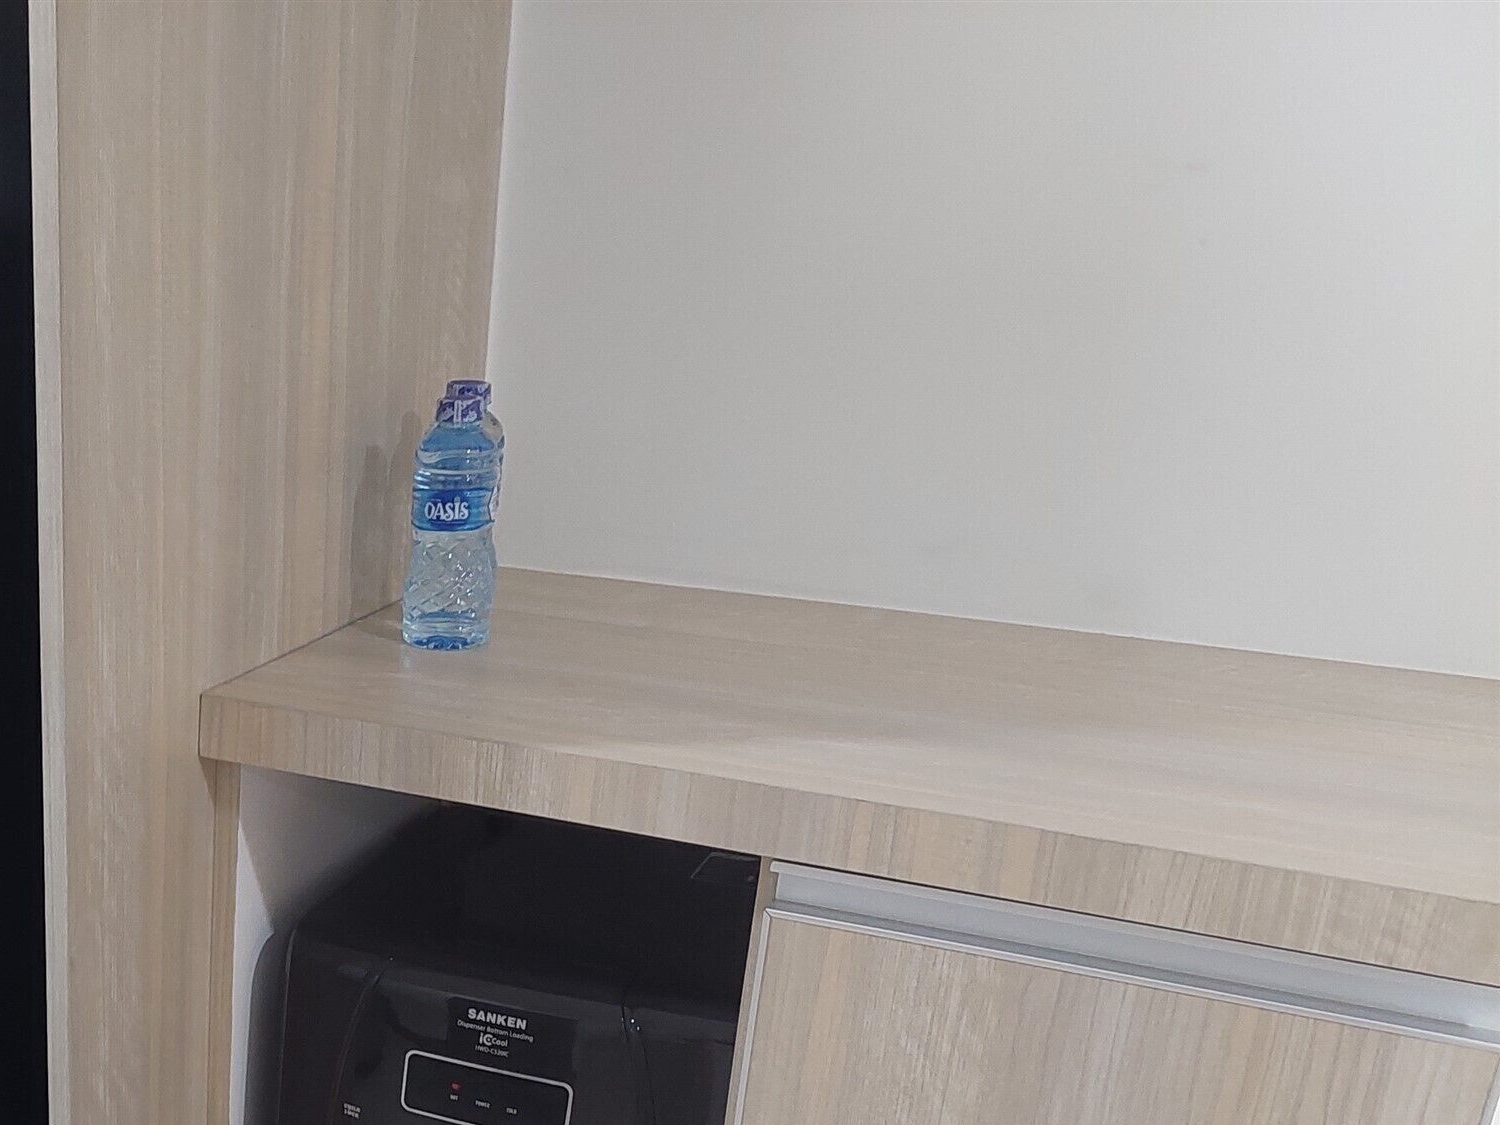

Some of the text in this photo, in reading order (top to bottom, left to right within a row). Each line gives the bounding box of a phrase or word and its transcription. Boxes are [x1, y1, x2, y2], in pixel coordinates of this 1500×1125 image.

[467, 1008, 527, 1030] SANKEN
[457, 1019, 485, 1032] Dispenser
[509, 1031, 534, 1043] Loading
